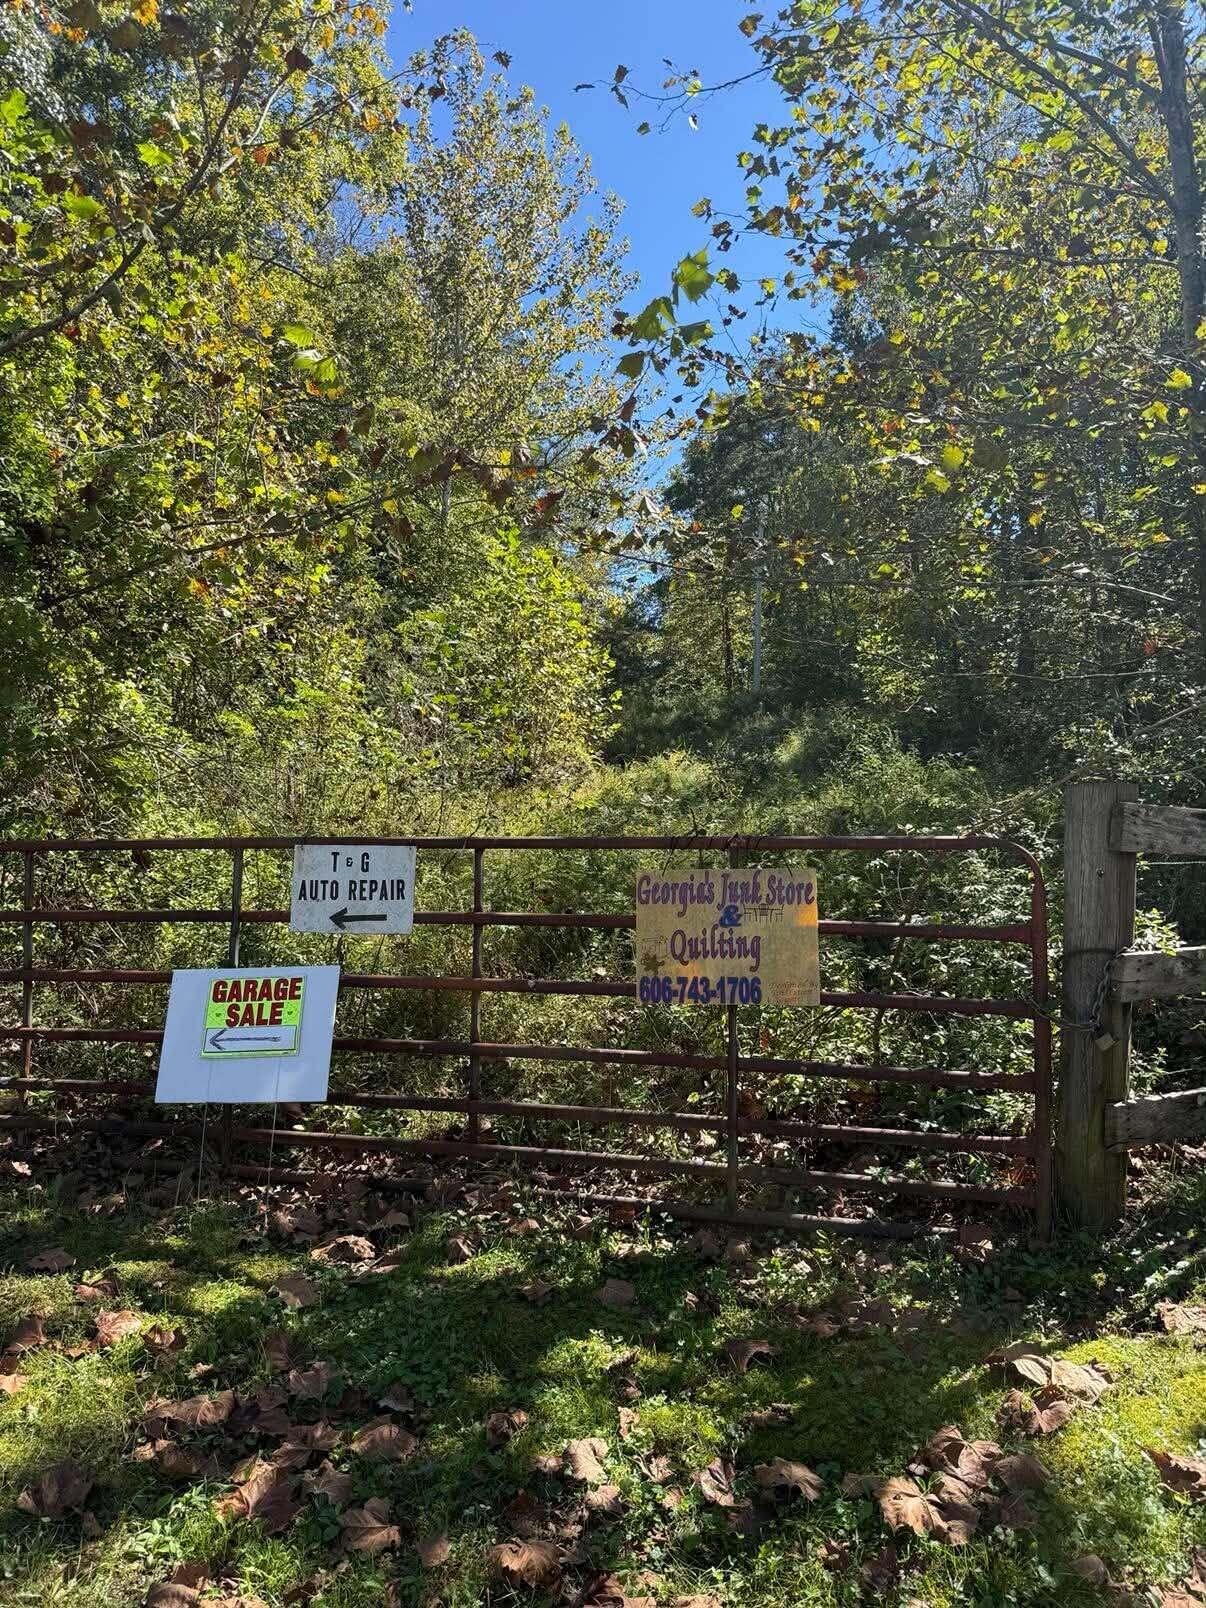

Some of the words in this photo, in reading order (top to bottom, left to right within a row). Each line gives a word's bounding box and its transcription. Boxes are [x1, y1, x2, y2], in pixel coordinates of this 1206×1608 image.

[331, 851, 340, 873] T
[346, 857, 354, 867] &
[360, 852, 370, 873] G
[298, 879, 339, 901] AUTO
[348, 879, 406, 901] REPAIR
[637, 871, 715, 918] Georgia's
[716, 869, 762, 911] Junk
[766, 874, 816, 906] Store
[718, 903, 744, 928] &
[670, 923, 762, 973] Quilting
[212, 977, 303, 1003] GARAGE
[639, 975, 763, 1005] 606-743-1706
[225, 1002, 284, 1027] SALE
